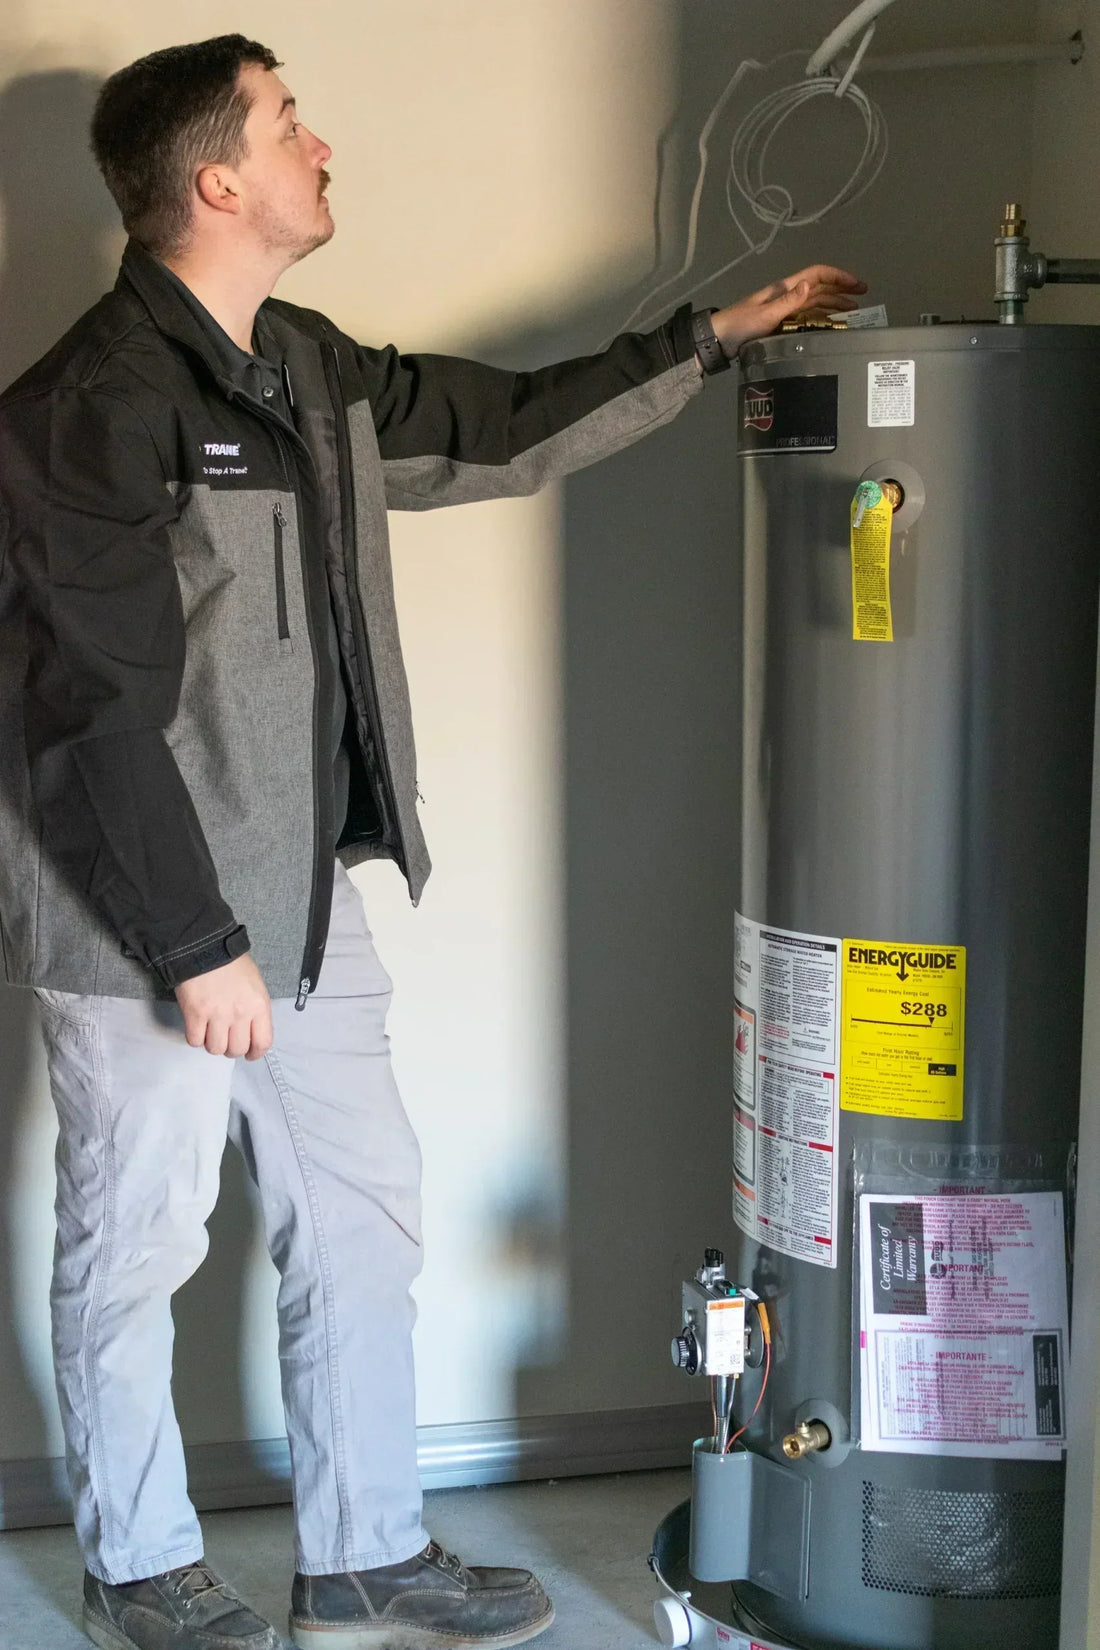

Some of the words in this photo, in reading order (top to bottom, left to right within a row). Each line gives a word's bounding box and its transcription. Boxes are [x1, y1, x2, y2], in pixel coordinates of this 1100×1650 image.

[204, 443, 240, 456] TRANE
[209, 467, 222, 475] Stop
[848, 947, 957, 970] ENERGYGUIDE
[900, 1001, 948, 1017] $288
[940, 1186, 986, 1195] IMPORTANT
[877, 1223, 891, 1237] of
[879, 1238, 892, 1290] Certificate
[892, 1239, 904, 1278] Limited
[906, 1235, 918, 1281] Warranty
[937, 1263, 984, 1273] IMPORTANT
[935, 1352, 987, 1361] IMPORTANTE
